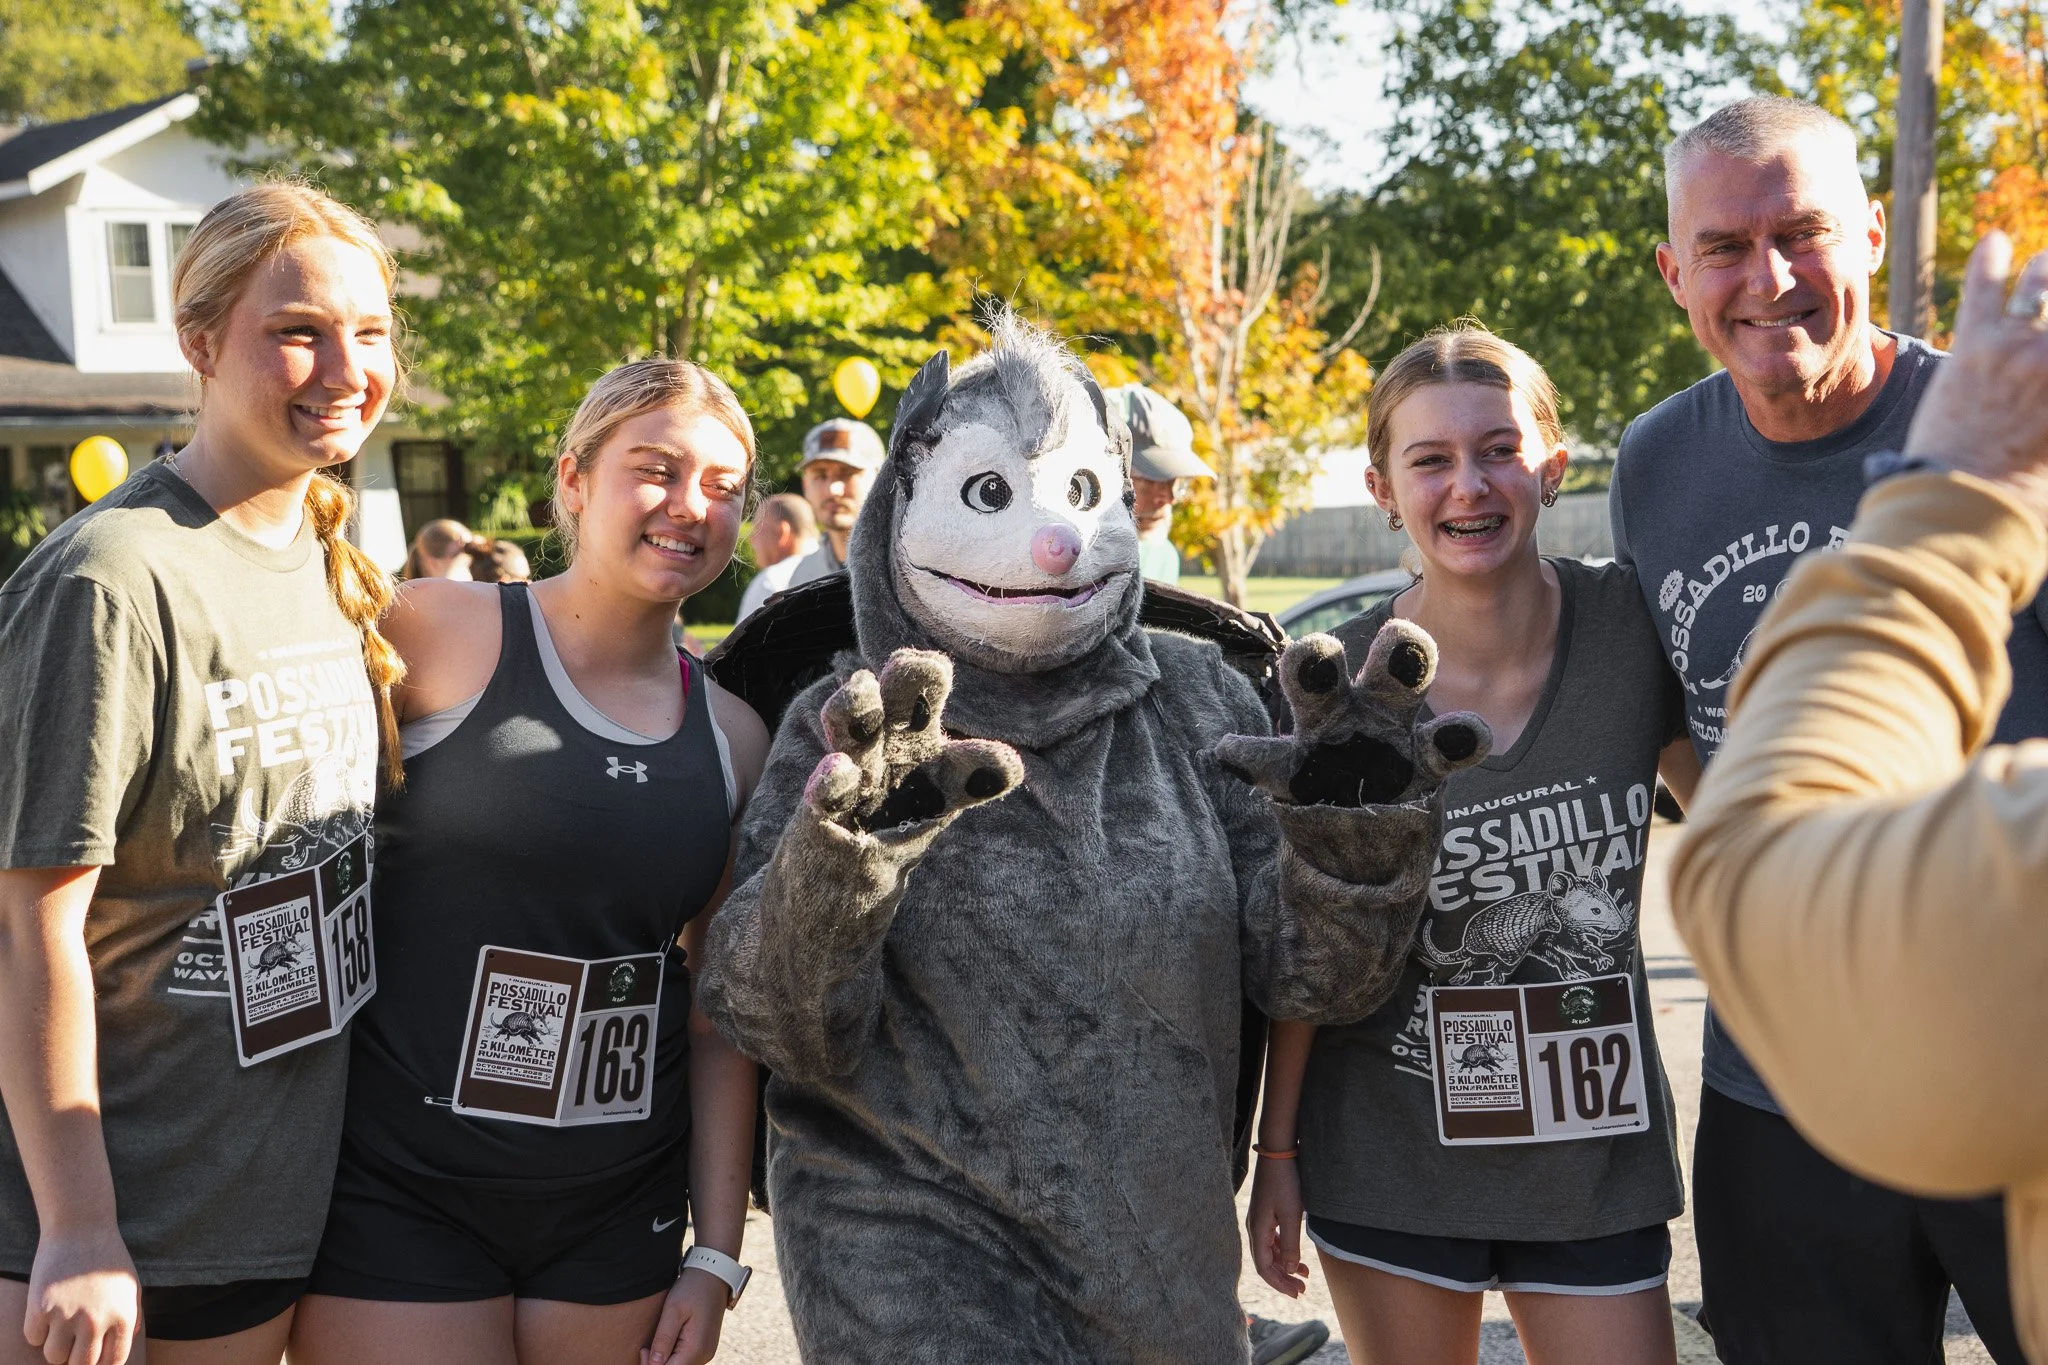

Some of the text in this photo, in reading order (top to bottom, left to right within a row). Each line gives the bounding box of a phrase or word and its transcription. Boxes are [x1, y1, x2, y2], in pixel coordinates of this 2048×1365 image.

[1742, 584, 1767, 603] 20
[1446, 781, 1582, 820] INAUGURAL
[1432, 783, 1649, 874] SSADILLO
[1428, 828, 1643, 912] ESTIVAL
[238, 905, 310, 940] POSSADILLO
[240, 920, 311, 953] FESTIVAL
[331, 895, 371, 1009] 158
[246, 985, 253, 996] 5
[255, 965, 315, 993] KILOMETER
[489, 981, 567, 1006] POSSADILLO
[487, 995, 563, 1019] FESTIVAL
[1443, 1019, 1513, 1033] POSSADILLO
[1444, 1032, 1514, 1045] FESTIVAL
[479, 1039, 556, 1061] 5 KILOMETER
[574, 1013, 650, 1107] 163
[1448, 1074, 1518, 1085] 5 KILOMETER
[1538, 1032, 1638, 1123] 162
